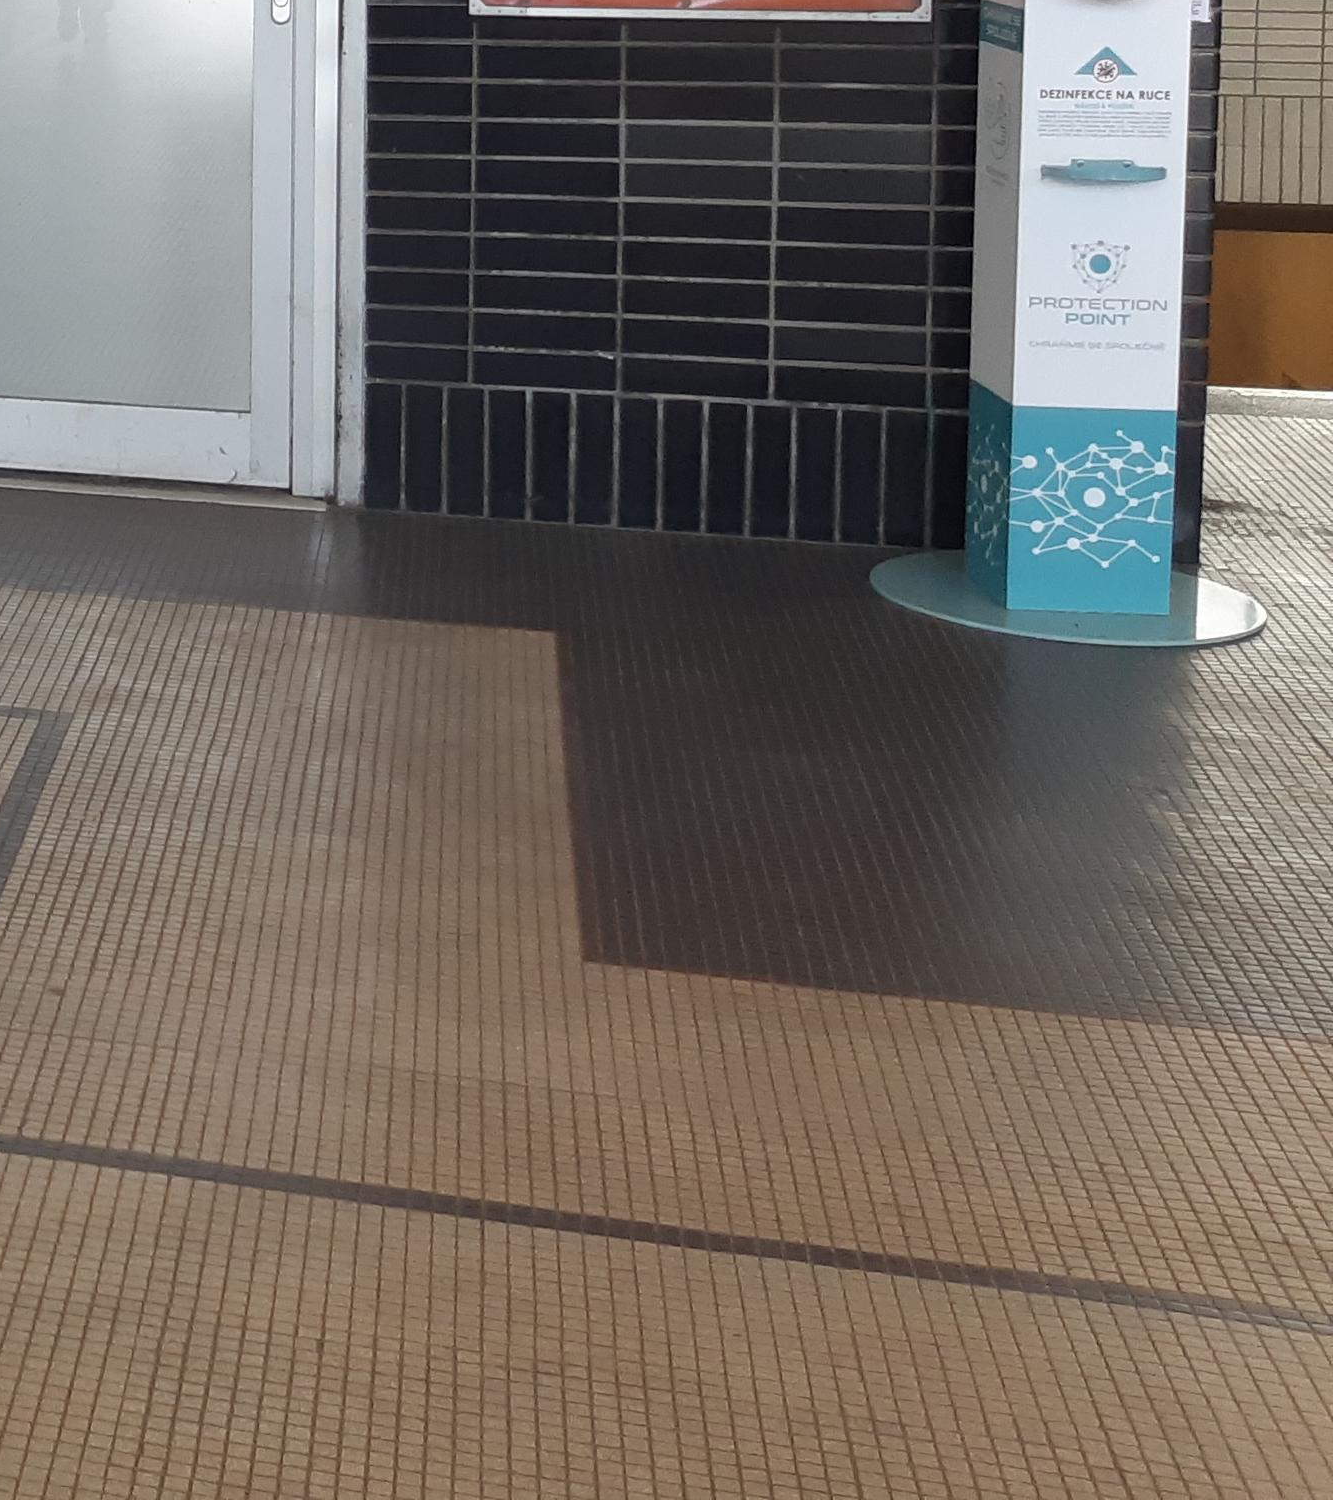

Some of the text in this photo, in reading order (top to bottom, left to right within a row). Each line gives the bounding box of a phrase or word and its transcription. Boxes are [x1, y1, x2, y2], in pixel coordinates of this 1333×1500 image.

[1039, 88, 1172, 101] DEZINFEKCE NA RUCE
[1028, 295, 1169, 312] PROTECTION
[1064, 312, 1131, 326] POINT
